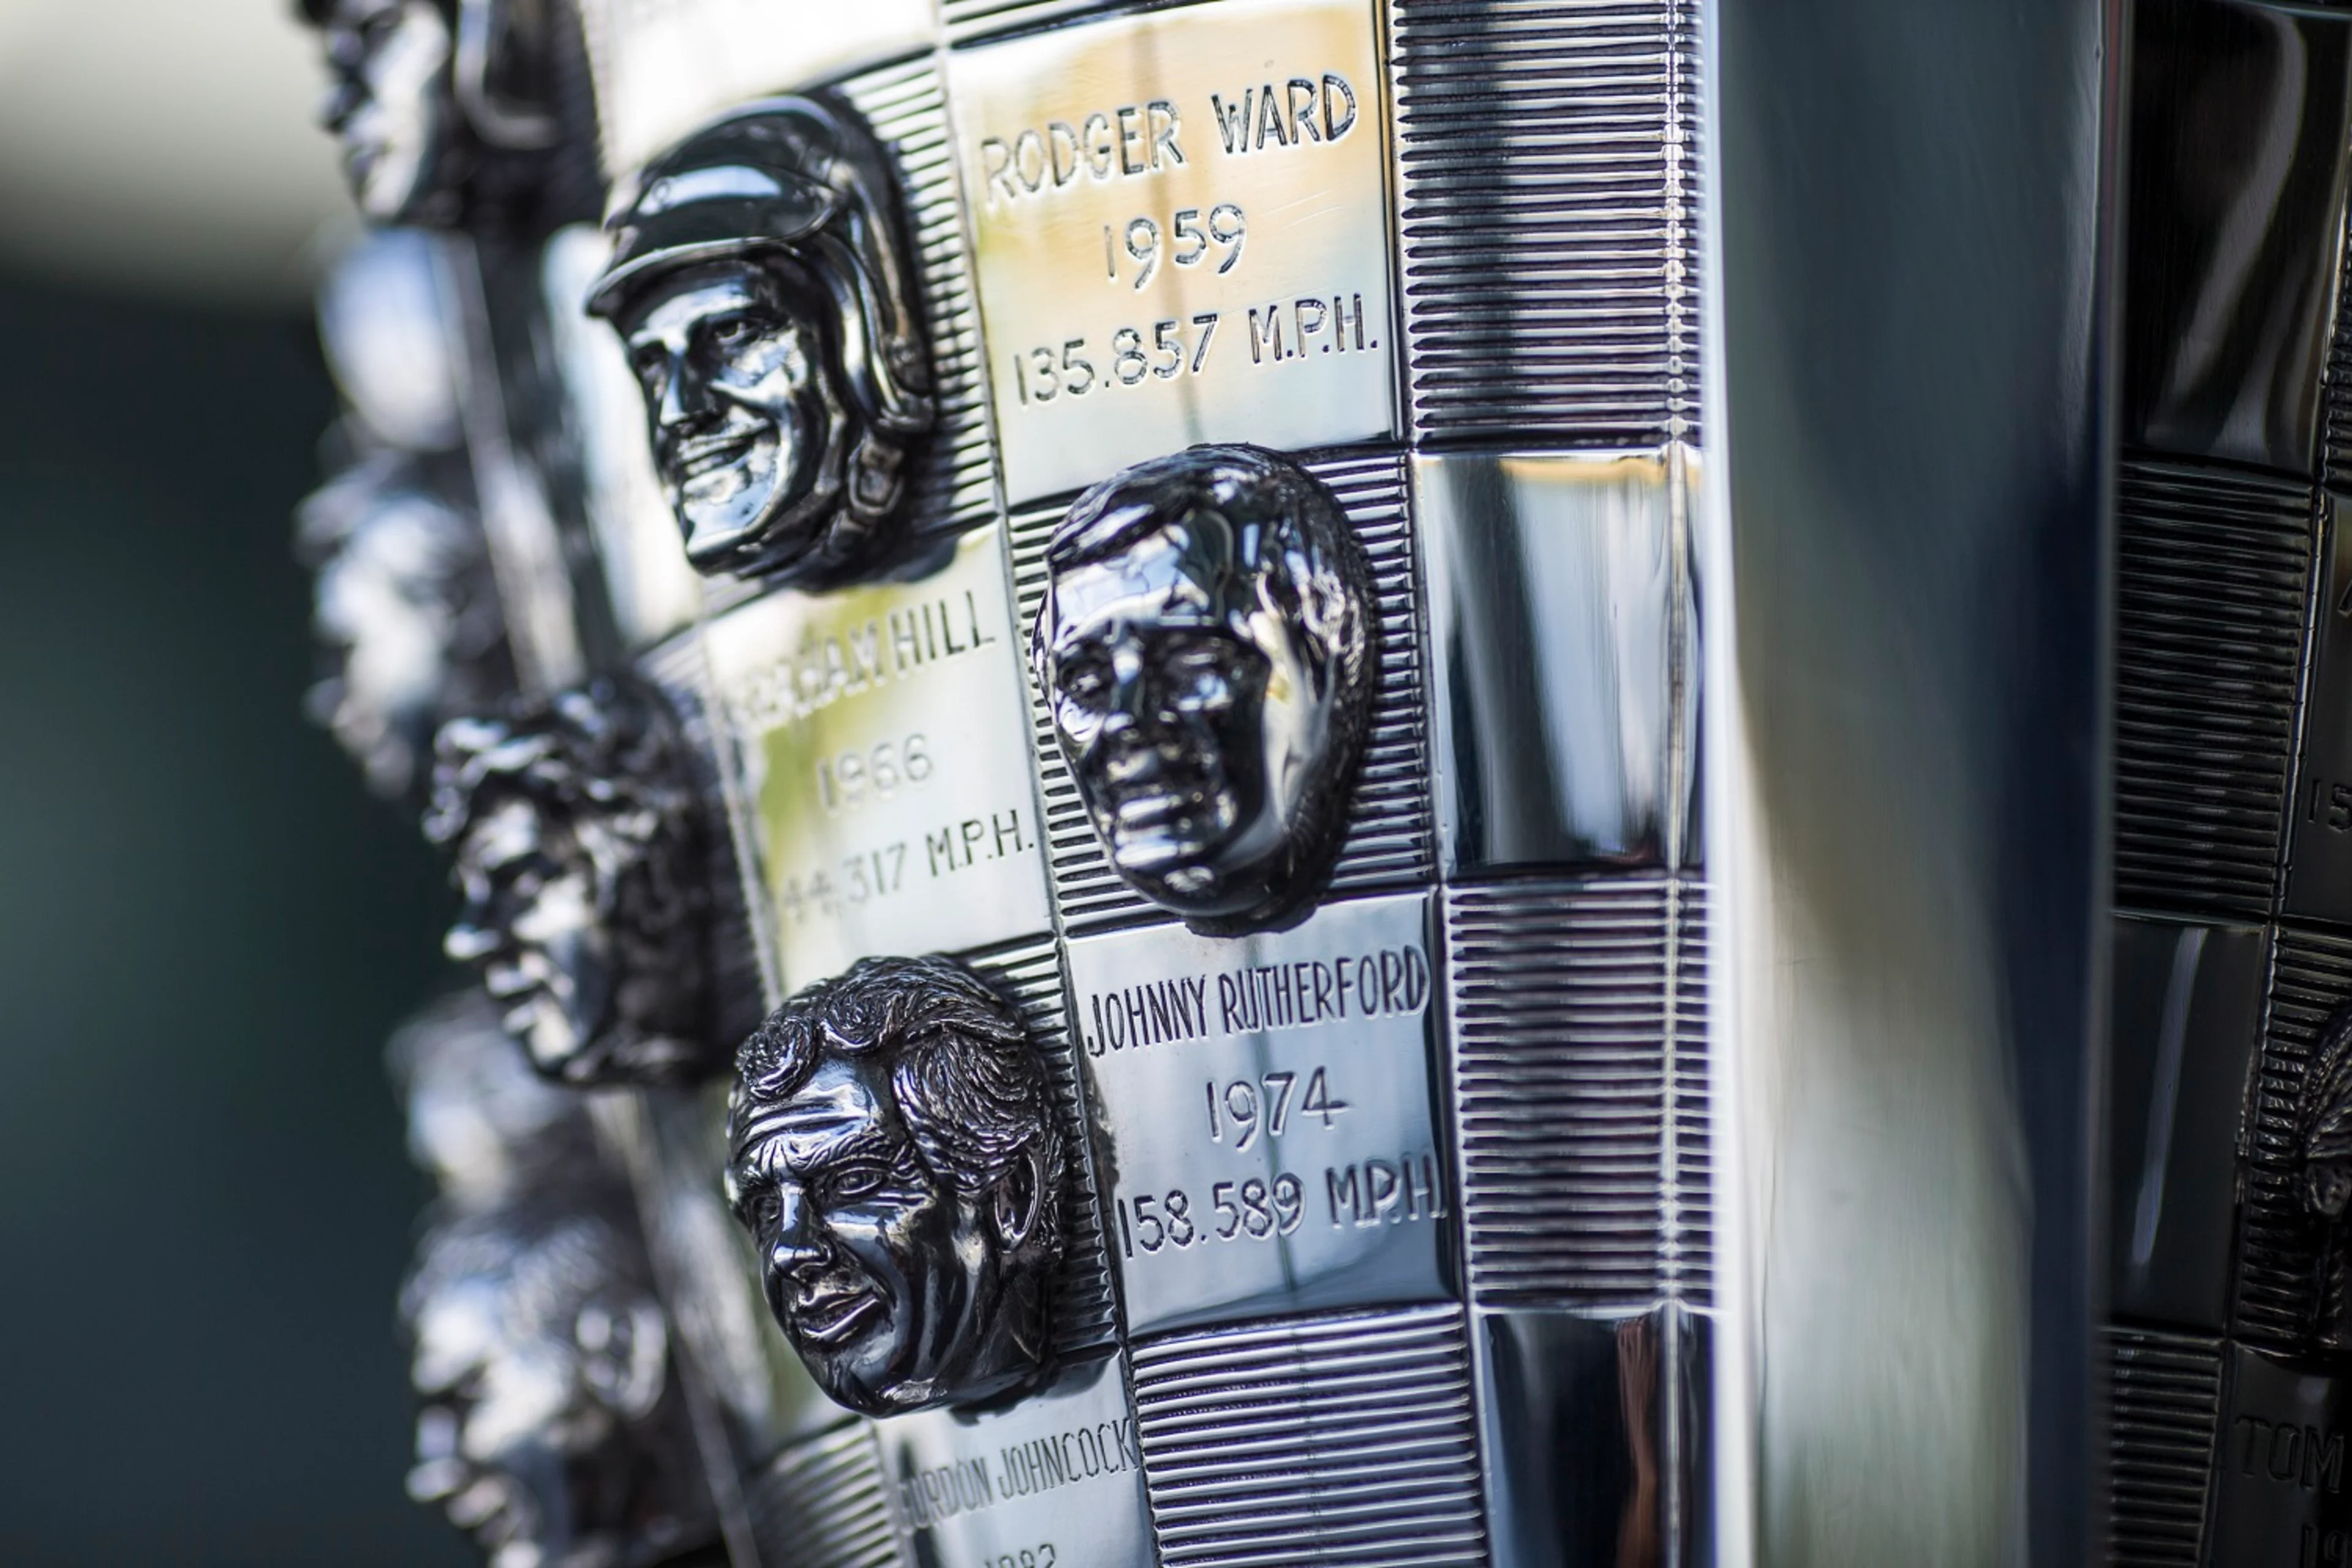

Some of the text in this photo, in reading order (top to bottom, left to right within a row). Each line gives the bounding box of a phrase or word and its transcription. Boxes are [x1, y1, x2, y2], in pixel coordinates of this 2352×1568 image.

[980, 74, 1357, 211] RODGER WARD
[1104, 203, 1246, 290] 1959
[1014, 293, 1379, 408] 135.857 M.P.H.
[888, 589, 996, 677] HILL
[925, 809, 1035, 877] M.P.H.
[1087, 944, 1430, 1057] JOHNNY RUTHERFORD
[1205, 1066, 1352, 1153] 1974
[1117, 1172, 1306, 1259] 158.589
[997, 1417, 1139, 1501] JOHNCOCK
[2234, 1414, 2345, 1494] TOM
